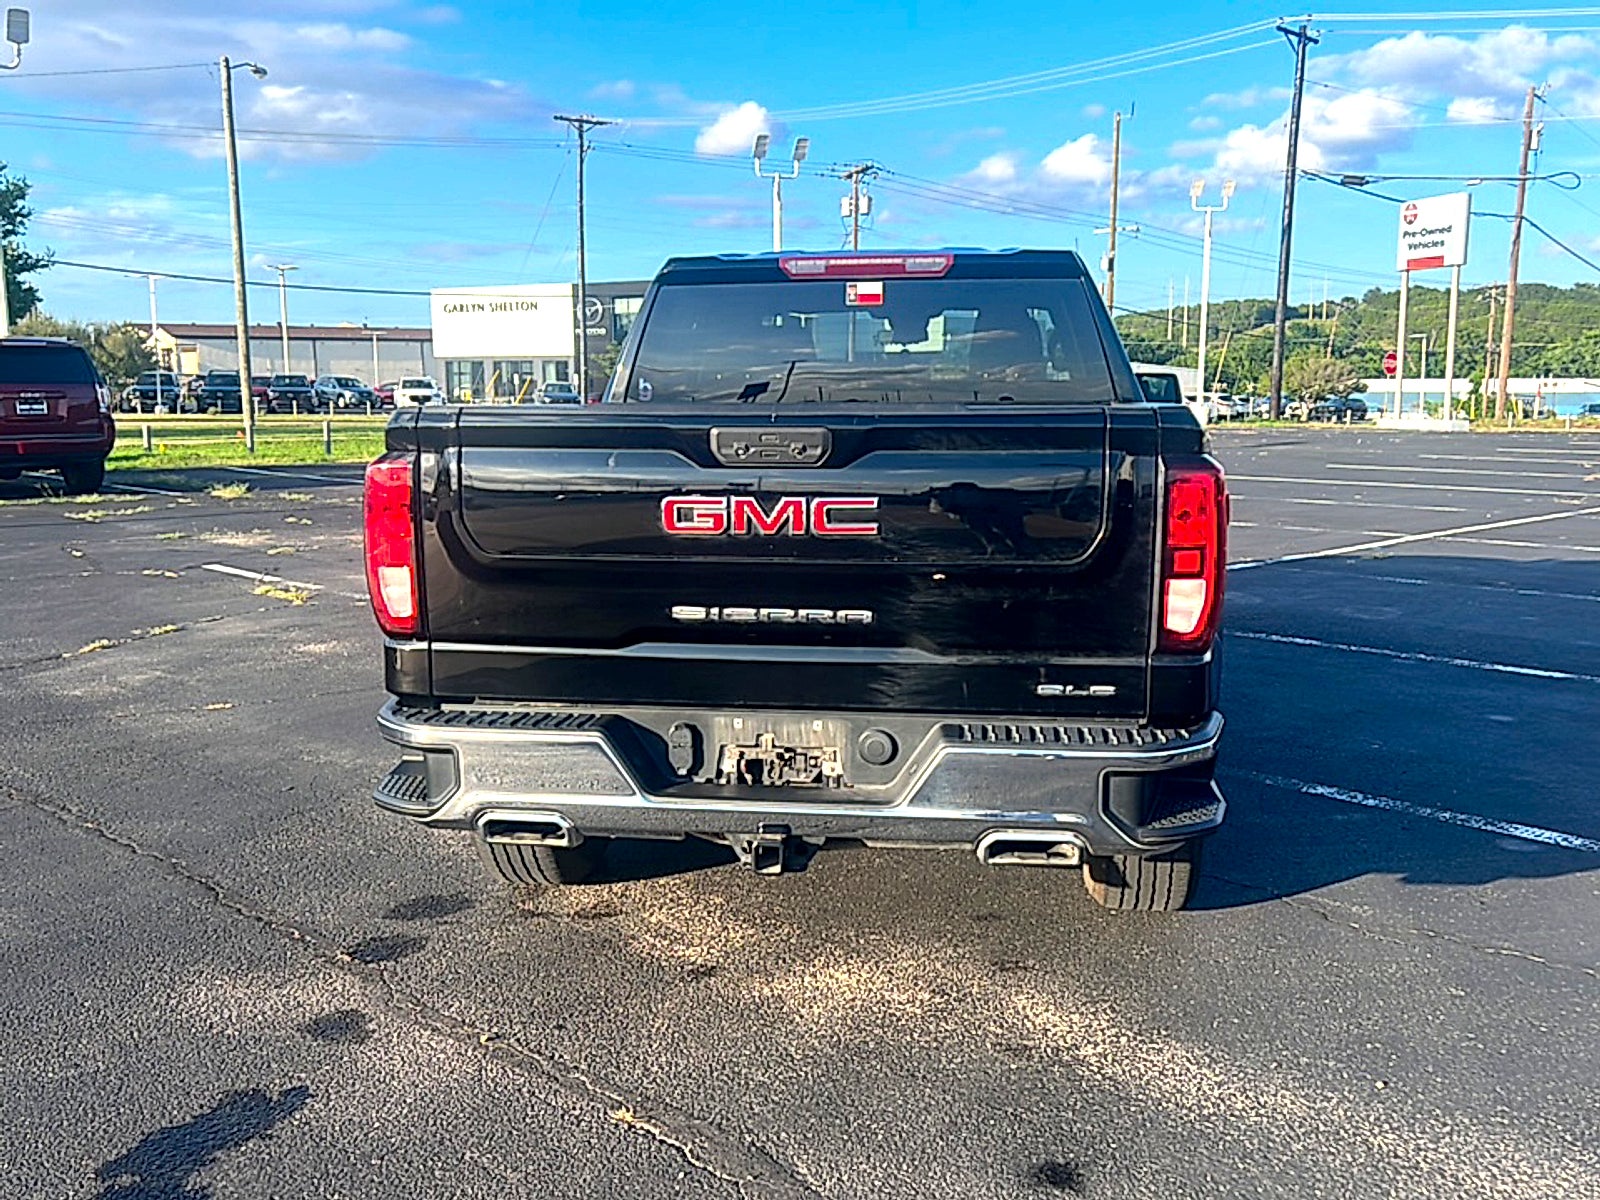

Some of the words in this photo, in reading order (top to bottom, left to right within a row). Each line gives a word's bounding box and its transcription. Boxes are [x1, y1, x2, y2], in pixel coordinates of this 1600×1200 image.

[1403, 225, 1452, 239] Pre-Owned
[1408, 240, 1445, 250] Vehicles
[488, 302, 538, 312] SHELTON
[661, 496, 879, 535] GMC
[671, 606, 873, 623] SIERRA
[1037, 684, 1116, 696] SLE
